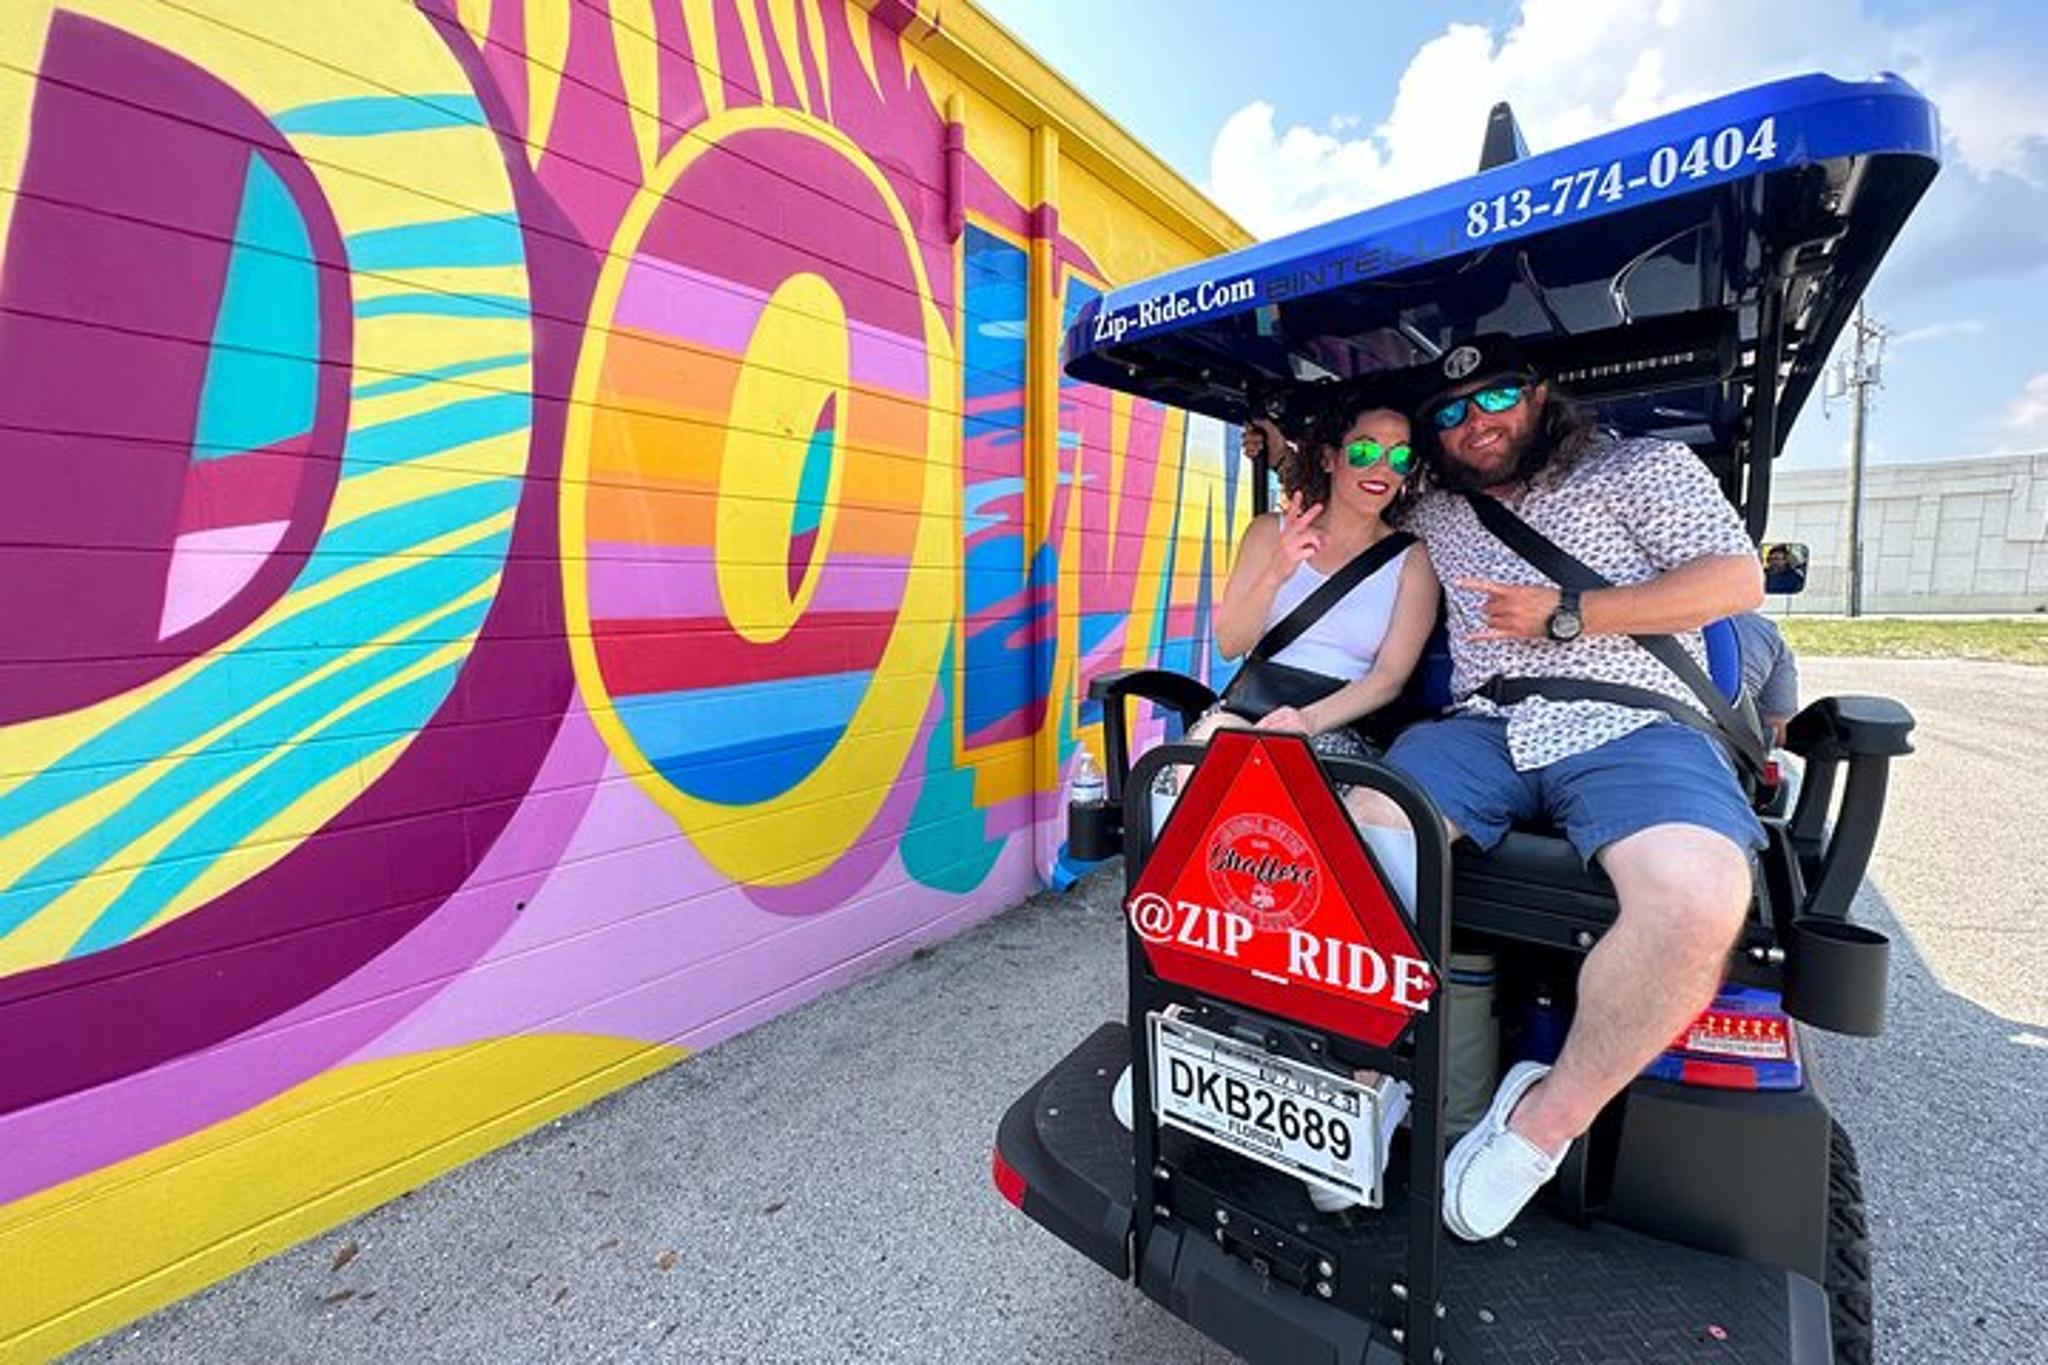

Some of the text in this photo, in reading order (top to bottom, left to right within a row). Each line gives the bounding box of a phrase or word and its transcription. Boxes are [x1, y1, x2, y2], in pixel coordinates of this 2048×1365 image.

[1466, 116, 1778, 239] 813-774-0404
[1094, 278, 1255, 342] Zip-Ride.Com
[1130, 892, 1430, 1012] @ZIP_RIDE
[1170, 1056, 1351, 1161] DKB2689
[1228, 1120, 1284, 1151] FLORIDA
